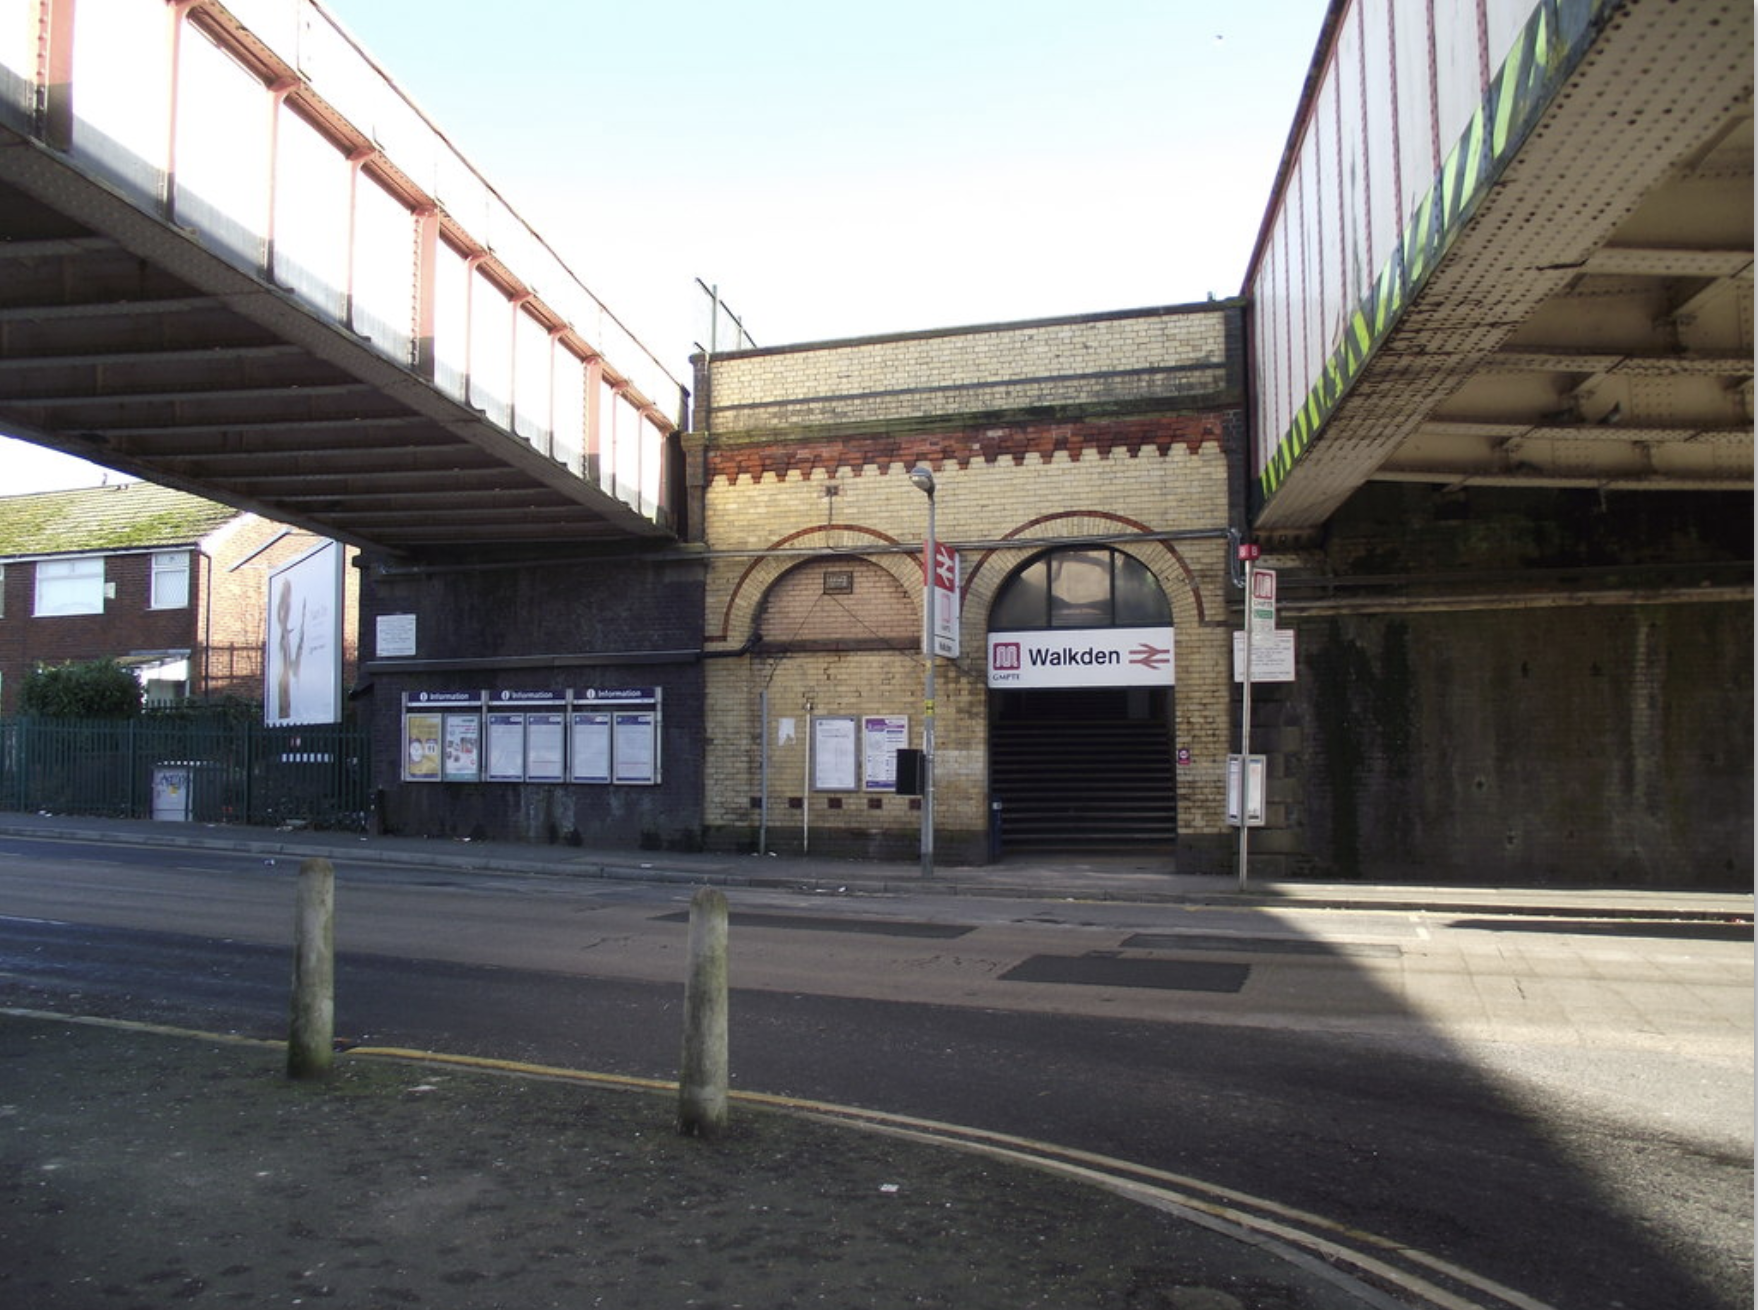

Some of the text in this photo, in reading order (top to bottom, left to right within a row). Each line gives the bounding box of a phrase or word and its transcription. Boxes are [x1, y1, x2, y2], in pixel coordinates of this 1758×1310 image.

[1028, 647, 1120, 666] Walkden
[430, 692, 469, 700] Information
[512, 691, 554, 699] Information
[598, 689, 642, 698] Information
